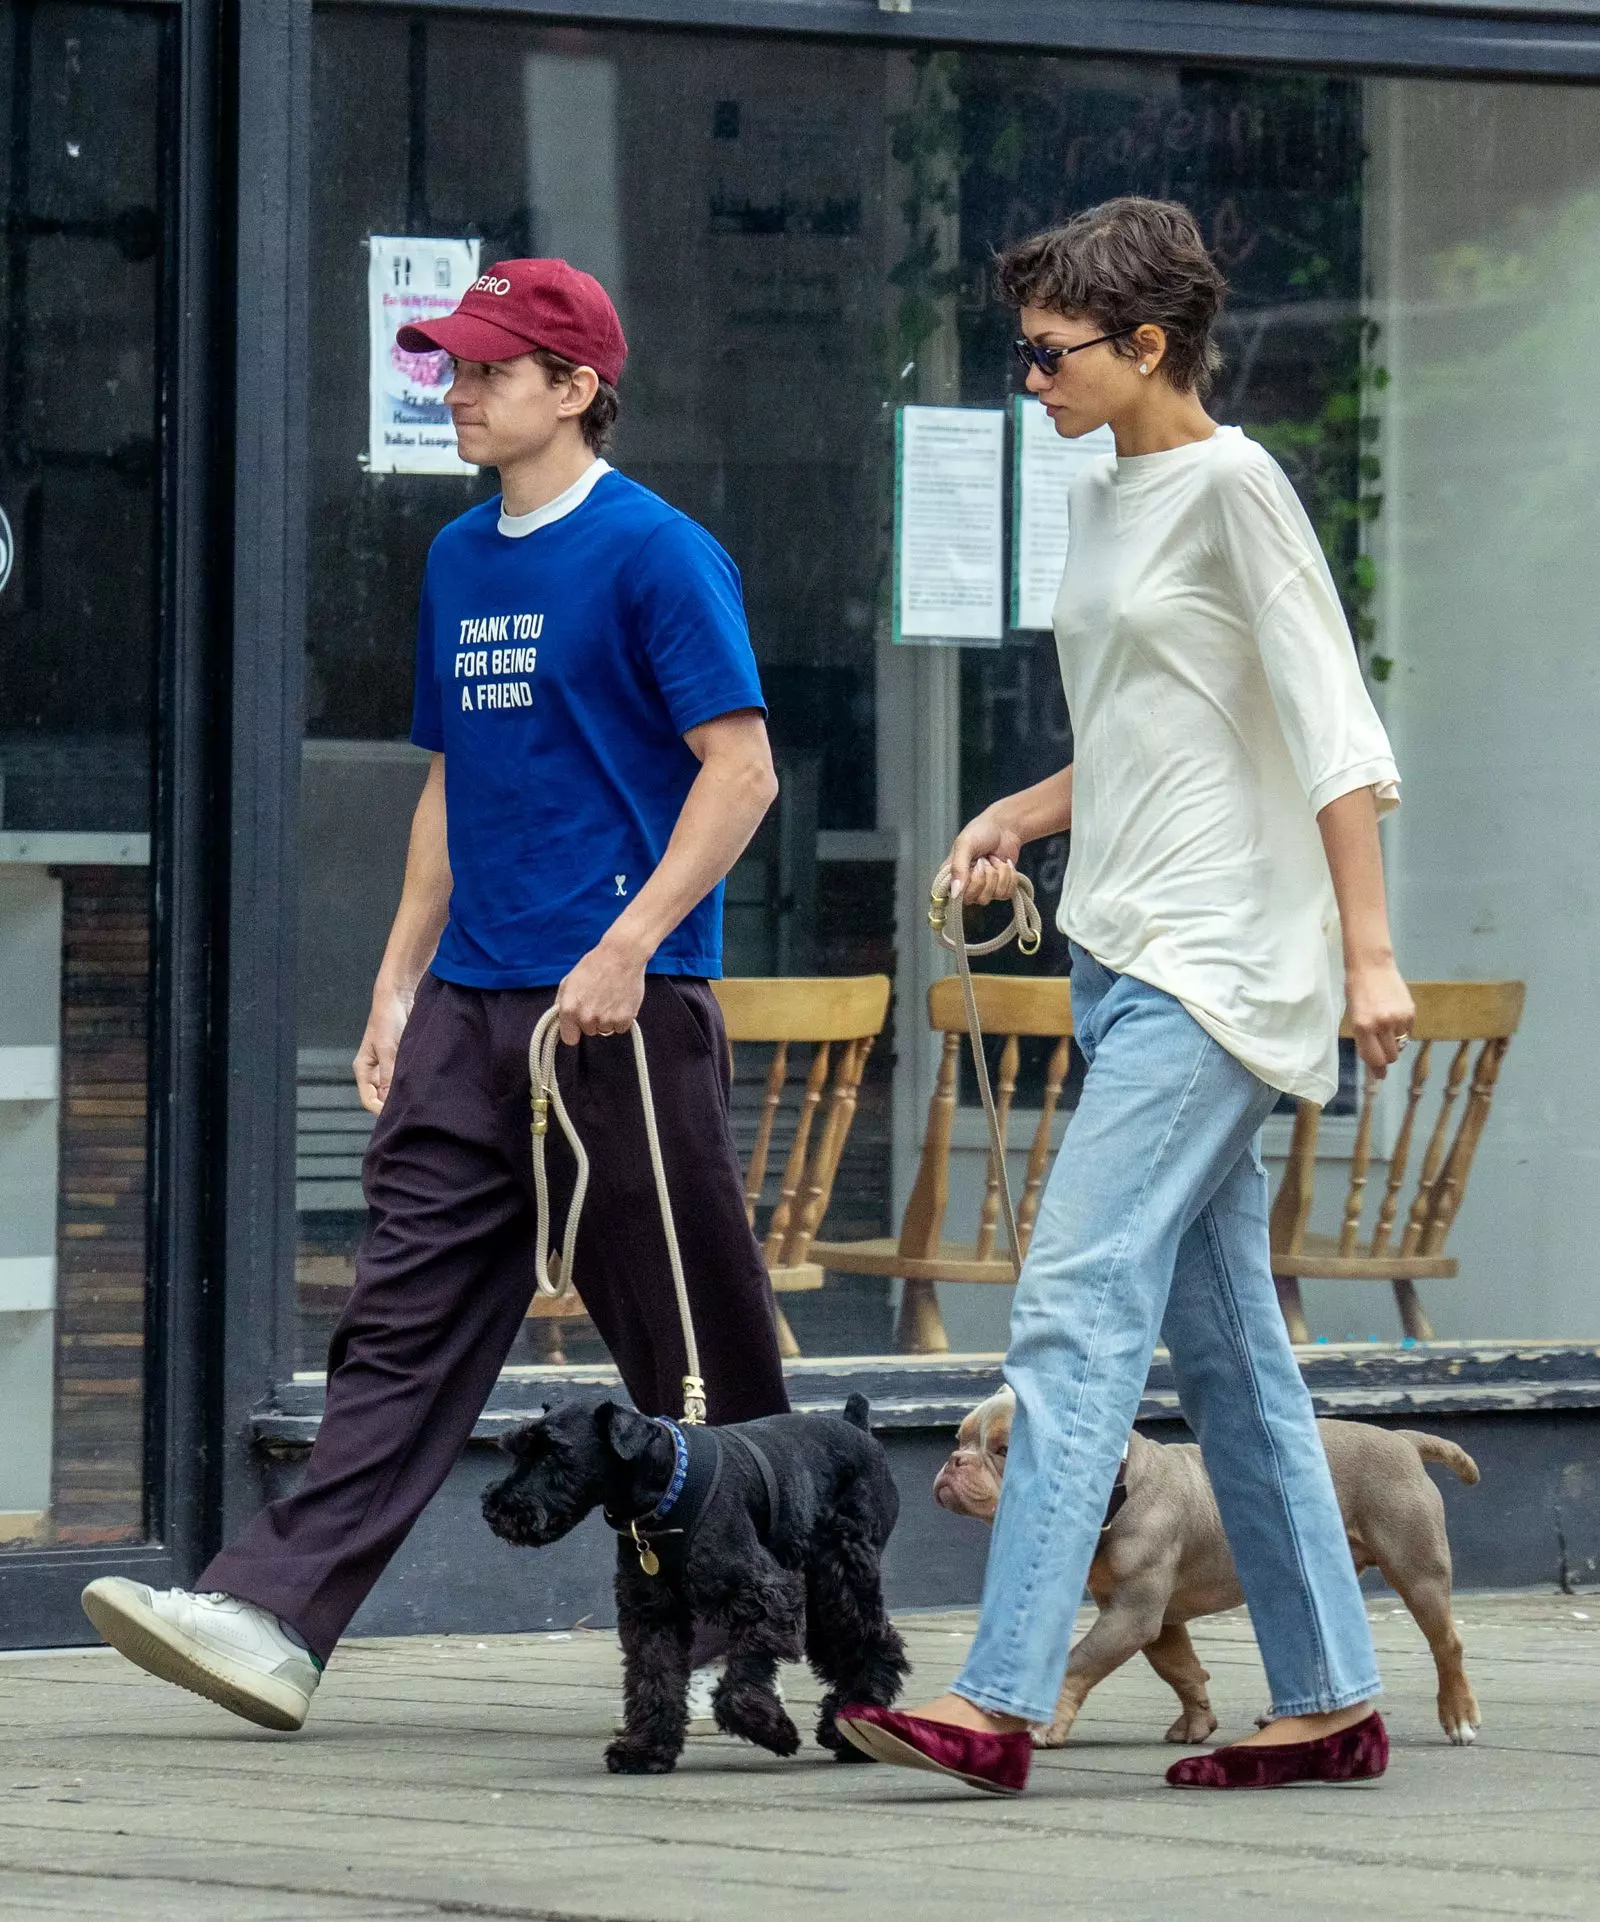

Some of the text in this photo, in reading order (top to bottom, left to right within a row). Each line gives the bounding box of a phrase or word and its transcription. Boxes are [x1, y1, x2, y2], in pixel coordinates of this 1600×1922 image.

[470, 275, 511, 296] ERO
[459, 613, 544, 645] THANK YOU
[454, 647, 537, 678] FOR BEING
[461, 681, 533, 712] A FRIEND
